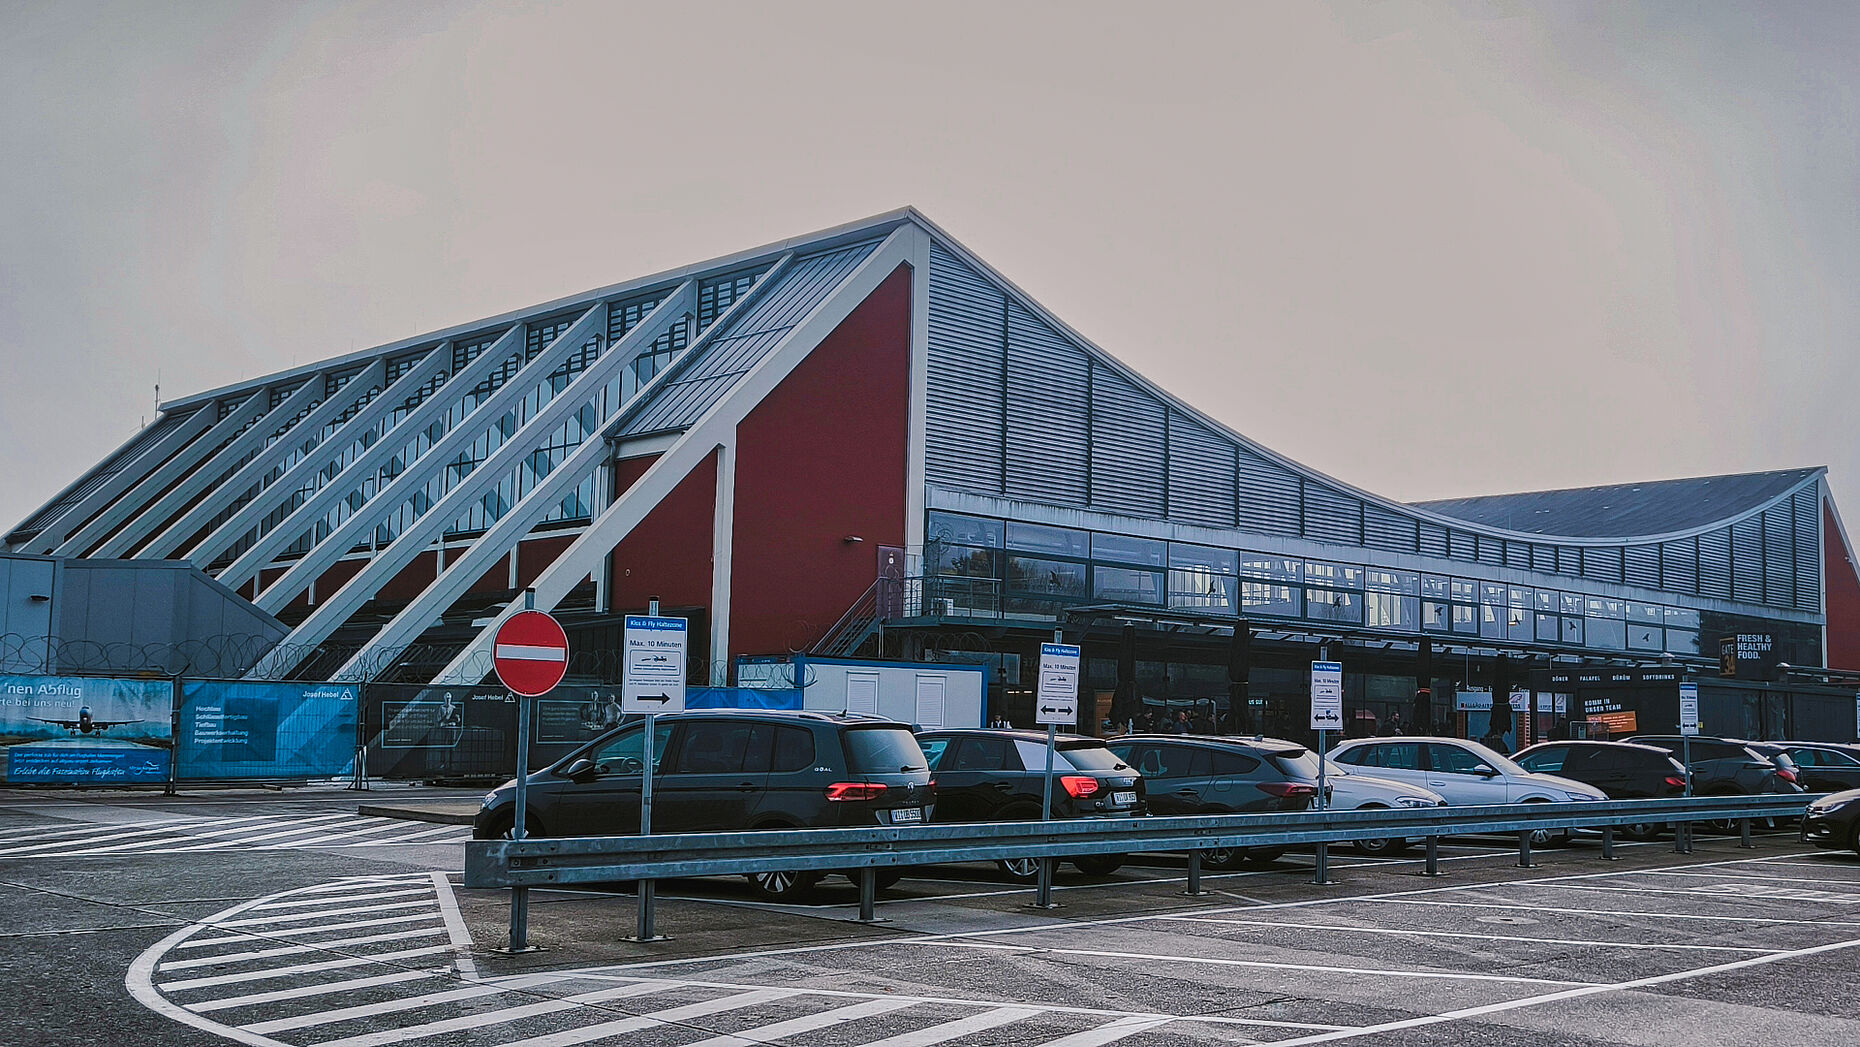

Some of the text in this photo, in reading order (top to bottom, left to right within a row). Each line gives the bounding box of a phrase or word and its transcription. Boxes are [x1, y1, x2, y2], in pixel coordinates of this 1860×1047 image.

[656, 640, 682, 648] Minuten
[1737, 643, 1772, 651] HEALTHY
[1738, 651, 1760, 660] FOOD.
[37, 683, 81, 698] Abflug
[16, 698, 30, 706] bei
[38, 766, 52, 775] die
[92, 766, 125, 779] Flughafen
